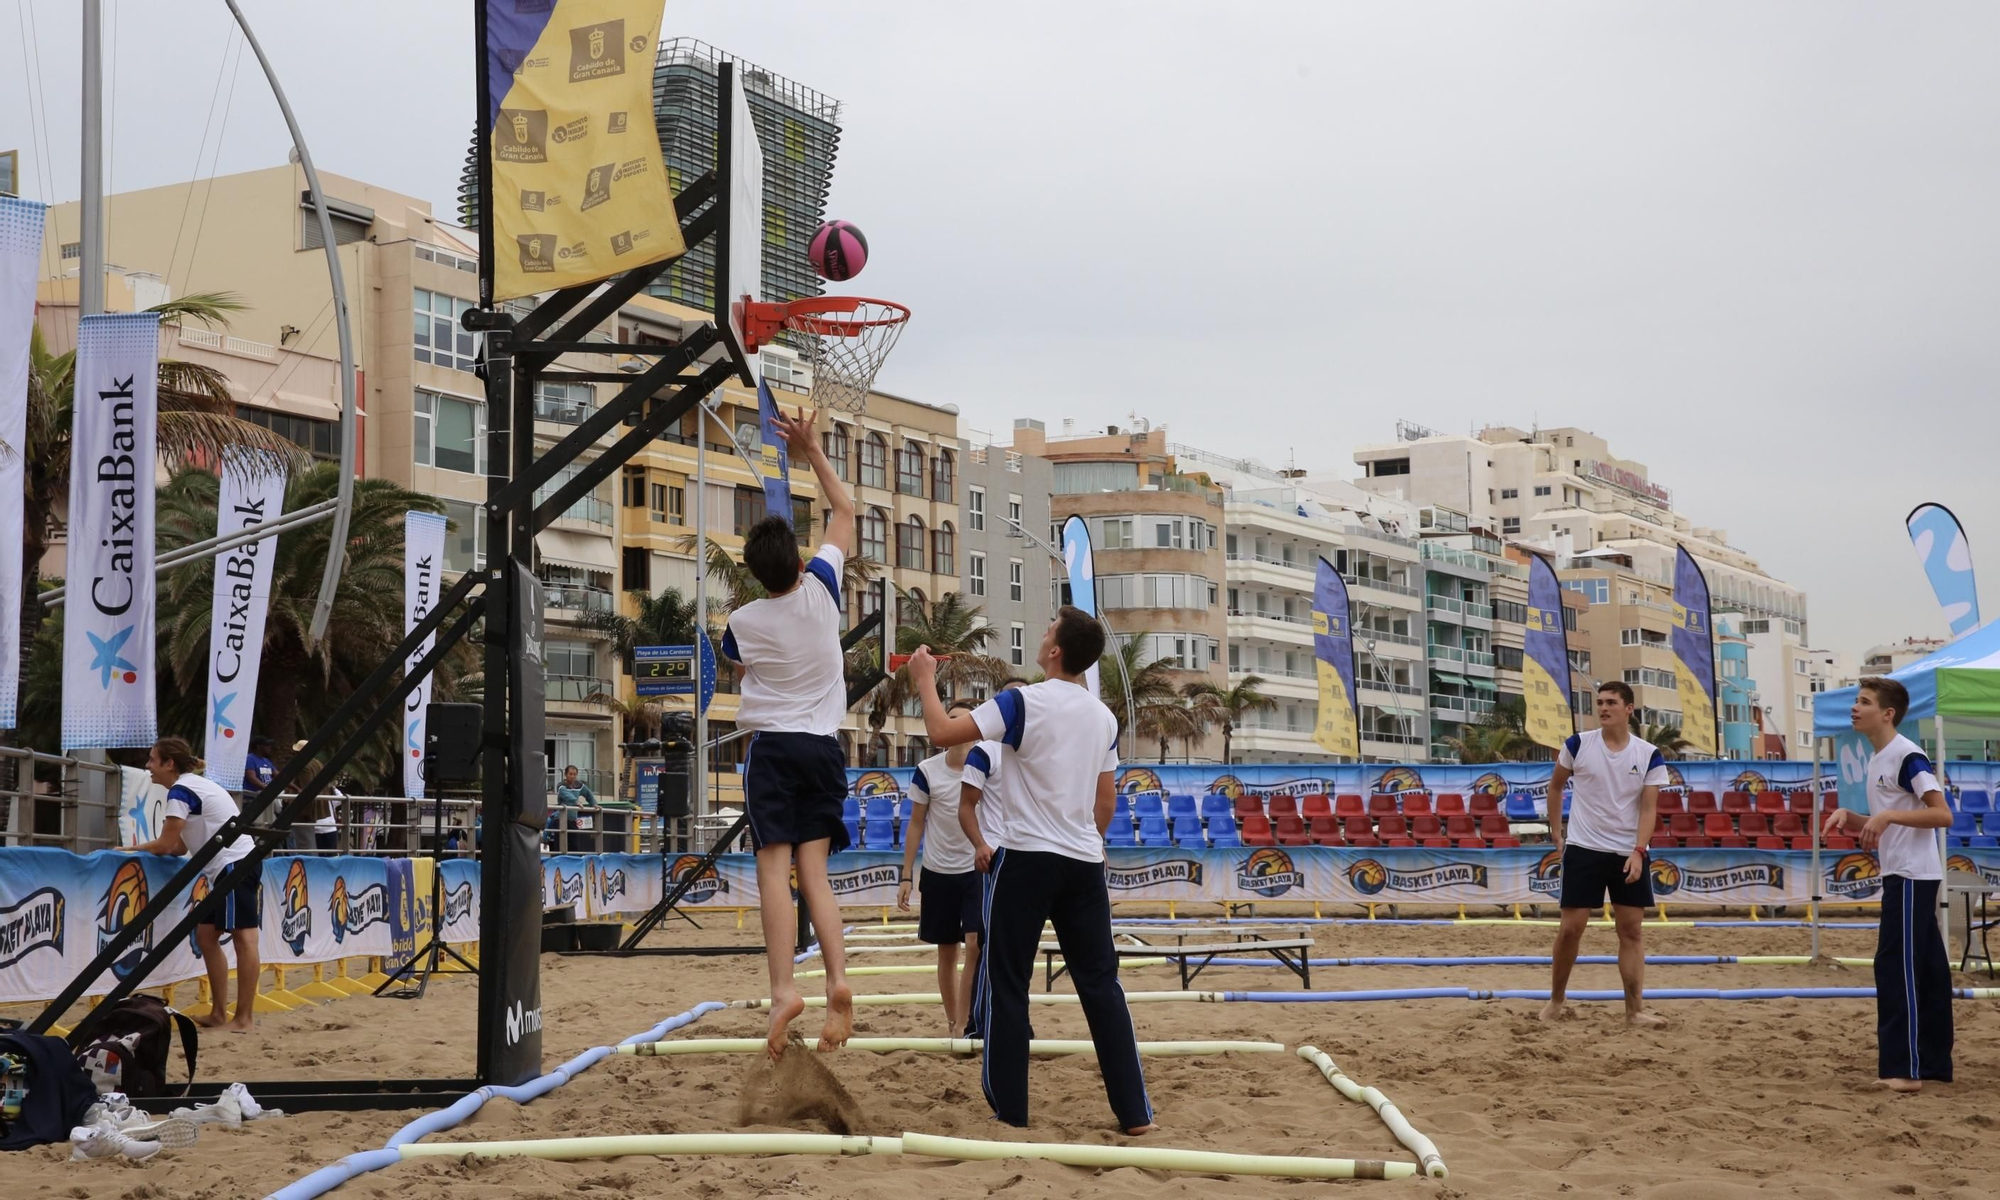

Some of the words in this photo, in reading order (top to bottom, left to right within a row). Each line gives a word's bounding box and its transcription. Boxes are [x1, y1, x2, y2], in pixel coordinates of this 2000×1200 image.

[573, 69, 590, 79] Gran
[591, 64, 620, 76] Canaria
[577, 60, 604, 72] Cabildo
[605, 58, 615, 66] de
[500, 150, 518, 160] Gran
[519, 152, 544, 160] Canaria
[503, 144, 531, 153] Cabildo
[531, 144, 538, 152] de
[92, 373, 135, 616] CaixaBank
[215, 497, 266, 684] CaixaBank
[1289, 782, 1319, 796] PLAYA
[862, 870, 896, 885] PLAYA
[1109, 869, 1150, 886] BASKET
[1152, 865, 1186, 880] PLAYA
[1240, 877, 1267, 888] BASKET
[1269, 874, 1292, 884] PLAYA
[1392, 873, 1433, 888] BASKET
[1436, 868, 1470, 882] PLAYA
[1686, 873, 1728, 887] BASKET
[1732, 868, 1766, 882] PLAYA
[694, 880, 718, 891] PLAYA
[1532, 880, 1560, 890] BASKET
[1828, 882, 1858, 892] BASKET
[24, 903, 52, 942] PLAYA
